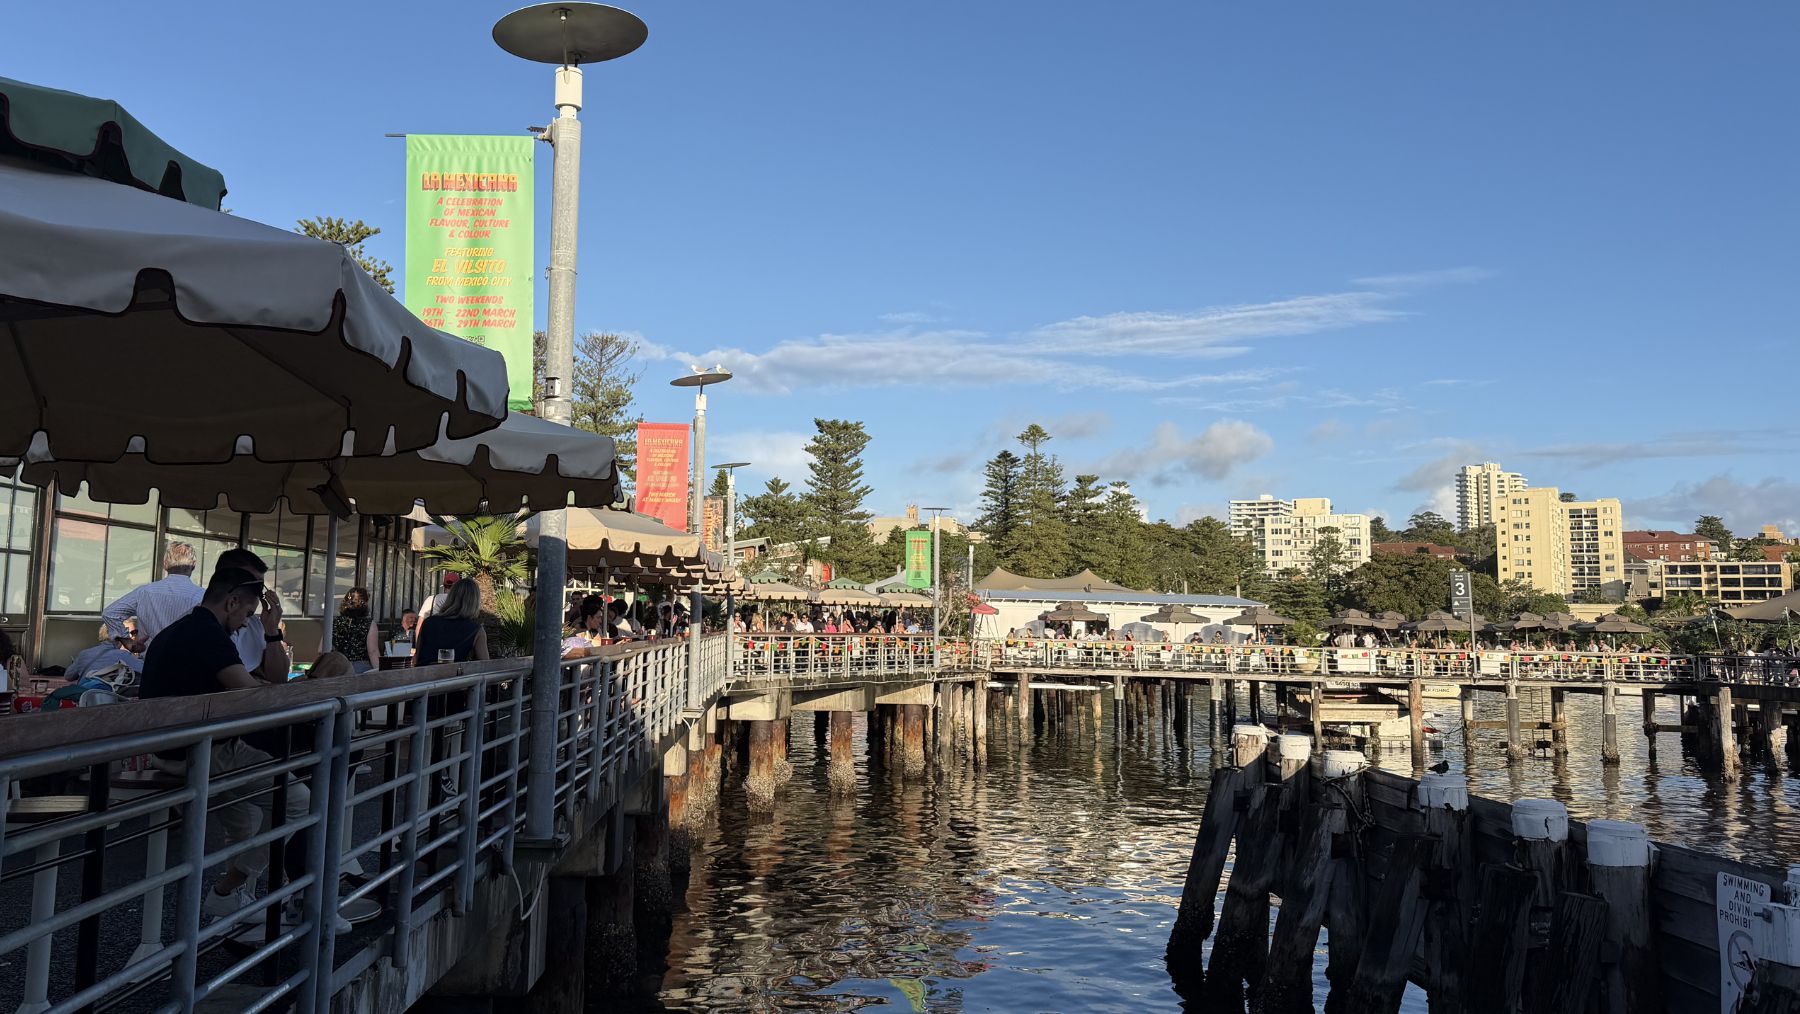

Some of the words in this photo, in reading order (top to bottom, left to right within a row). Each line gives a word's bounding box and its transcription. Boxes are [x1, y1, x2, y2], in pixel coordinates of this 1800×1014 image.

[422, 171, 440, 191] LA
[442, 172, 518, 192] MEXICANA
[437, 196, 444, 206] A
[446, 197, 503, 206] CELEBRATION
[443, 208, 455, 216] OF
[457, 208, 497, 217] MEXICAN
[429, 218, 470, 228] FLAVOUR,
[473, 219, 510, 228] CULTURE
[448, 230, 455, 239] &
[458, 230, 491, 239] COLOUR
[445, 248, 494, 257] FEATURING
[432, 258, 449, 273] EL
[455, 259, 506, 274] VILSITO
[427, 276, 453, 286] FROM
[455, 276, 488, 286] MEXICO
[490, 276, 512, 286] CITY
[435, 295, 455, 304] TWO
[457, 296, 504, 305] WEEKENDS
[422, 308, 444, 317] 19TH
[455, 308, 480, 317] 22ND
[482, 308, 516, 318] MARCH
[457, 319, 480, 328] 29TH
[482, 319, 516, 328] MARCH
[1455, 582, 1465, 596] 3
[1723, 875, 1765, 897] SWIMMING
[1734, 890, 1752, 904] AND
[1728, 900, 1753, 917] DIVIN
[1719, 909, 1752, 929] PROHIBI
